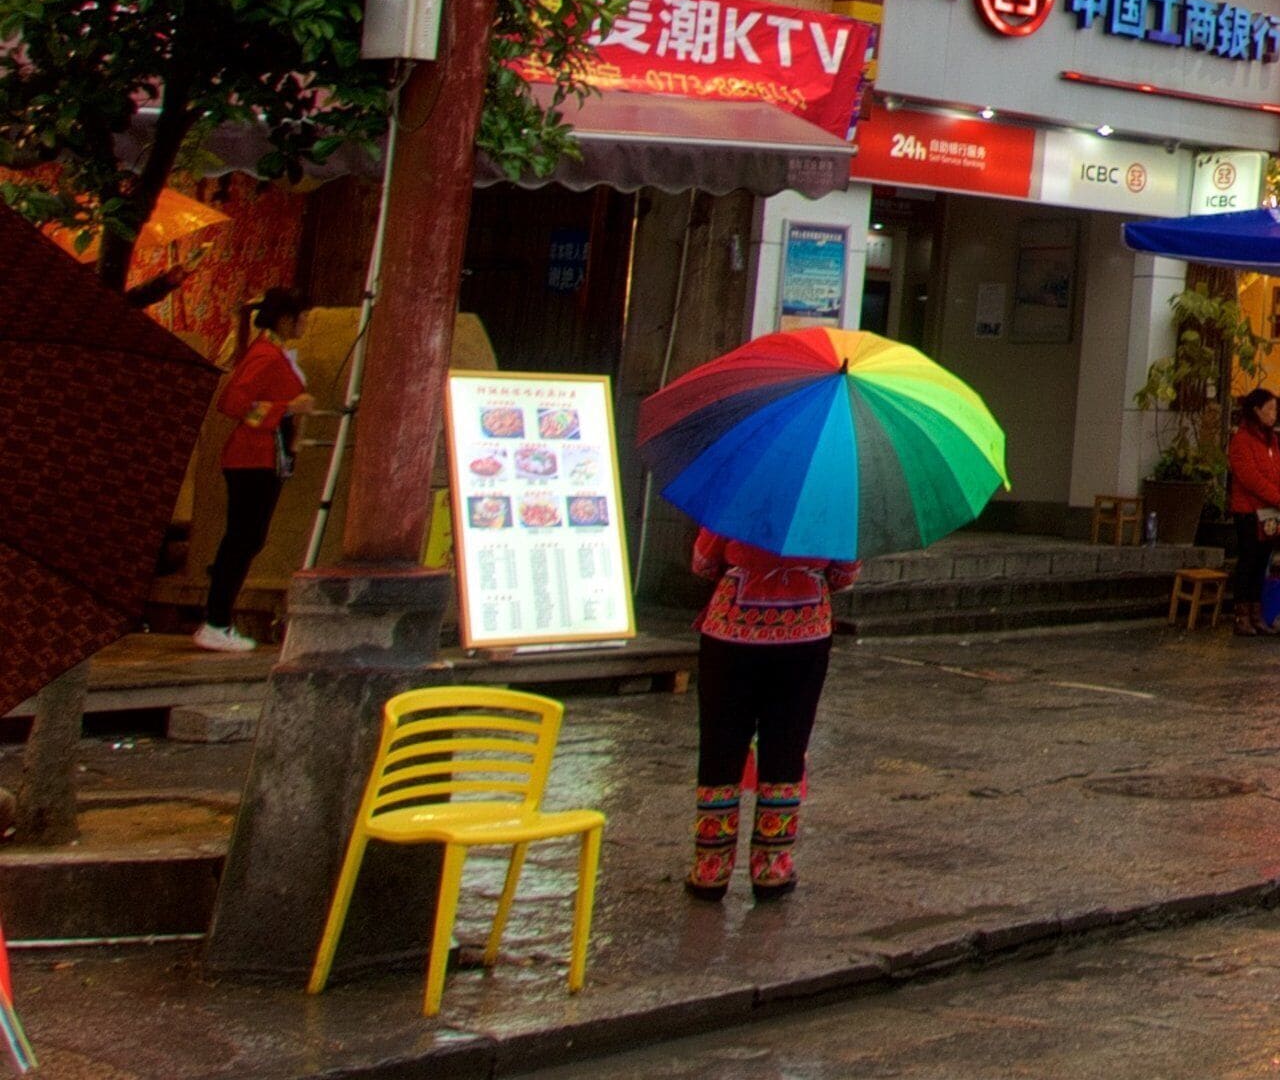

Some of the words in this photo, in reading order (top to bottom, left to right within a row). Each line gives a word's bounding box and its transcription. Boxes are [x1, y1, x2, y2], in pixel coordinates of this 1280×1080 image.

[890, 133, 927, 161] 24h
[929, 139, 986, 160] 自助银行服务
[1080, 163, 1120, 184] ICBC
[1205, 195, 1238, 208] ICBC
